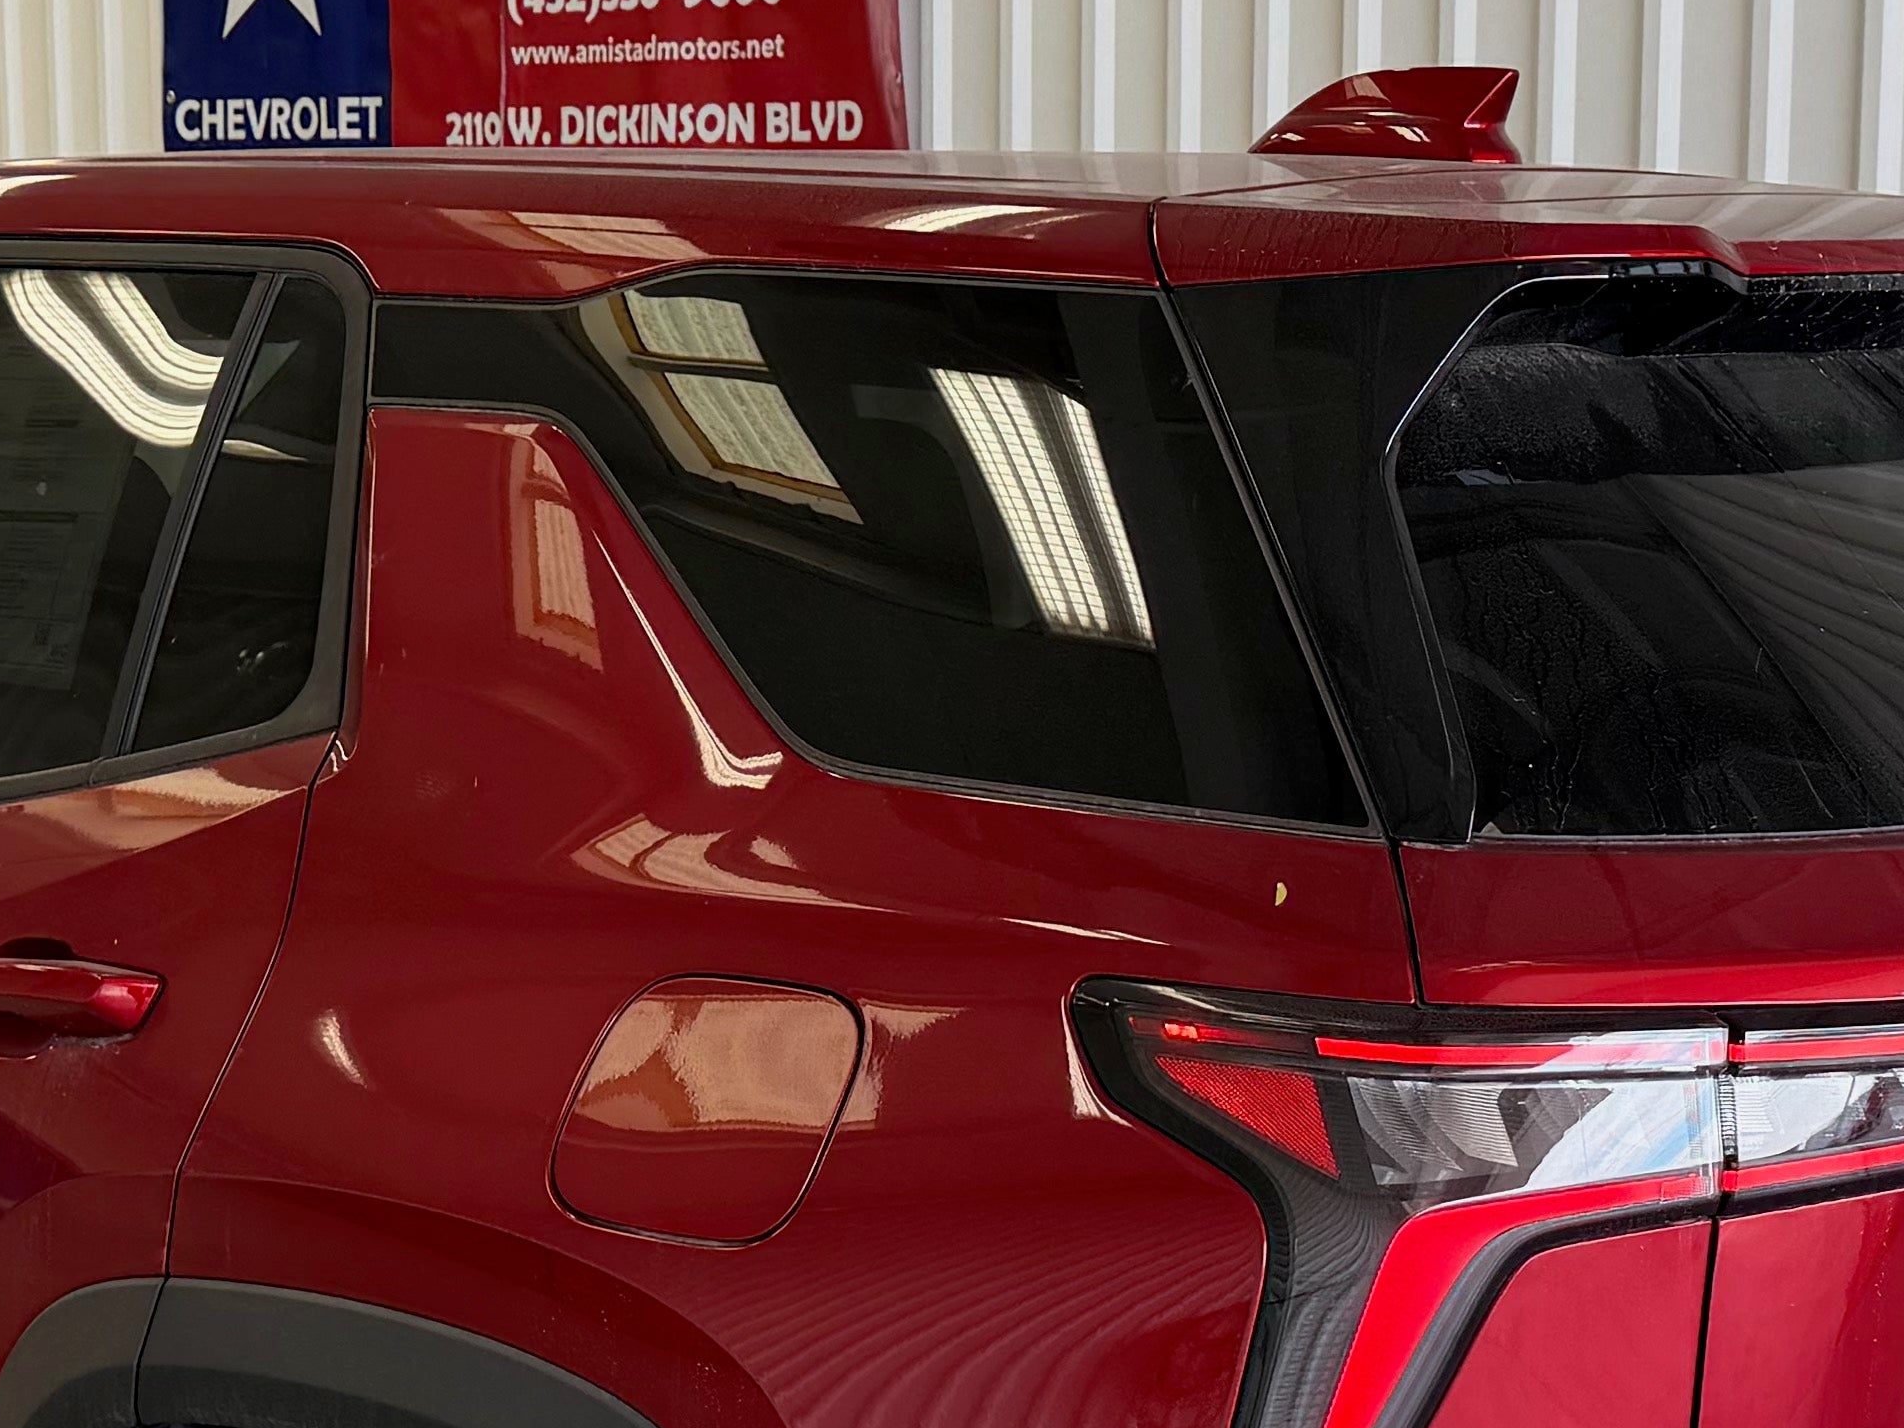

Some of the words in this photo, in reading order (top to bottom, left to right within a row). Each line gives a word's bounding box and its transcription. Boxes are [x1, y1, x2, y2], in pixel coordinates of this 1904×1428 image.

[511, 33, 785, 65] www.amistadmotors.net
[175, 96, 383, 142] CHEVROLET
[445, 111, 502, 147] 2110
[507, 106, 552, 146] W.
[559, 102, 756, 146] DICKINSON
[765, 99, 864, 143] BLVD
